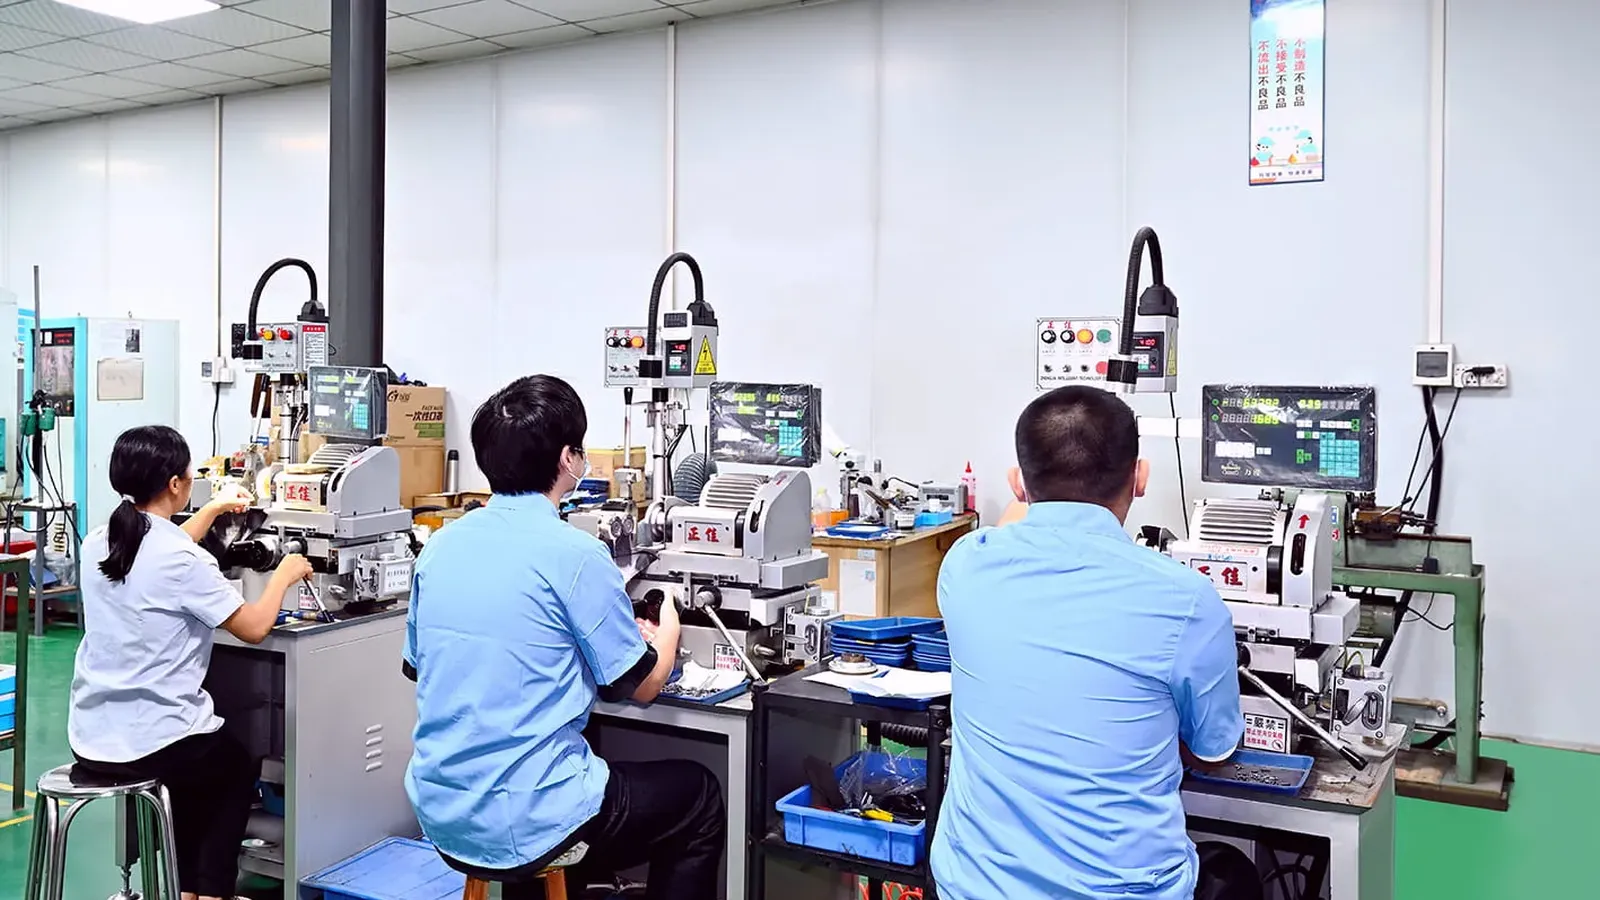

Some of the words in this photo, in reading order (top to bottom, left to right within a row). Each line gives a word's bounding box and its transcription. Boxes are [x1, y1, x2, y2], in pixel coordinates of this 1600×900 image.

[1257, 40, 1269, 111] 不流出不良品
[1275, 39, 1288, 109] 不接受不良品
[286, 485, 312, 501] 正佳
[687, 526, 720, 543] 正佳
